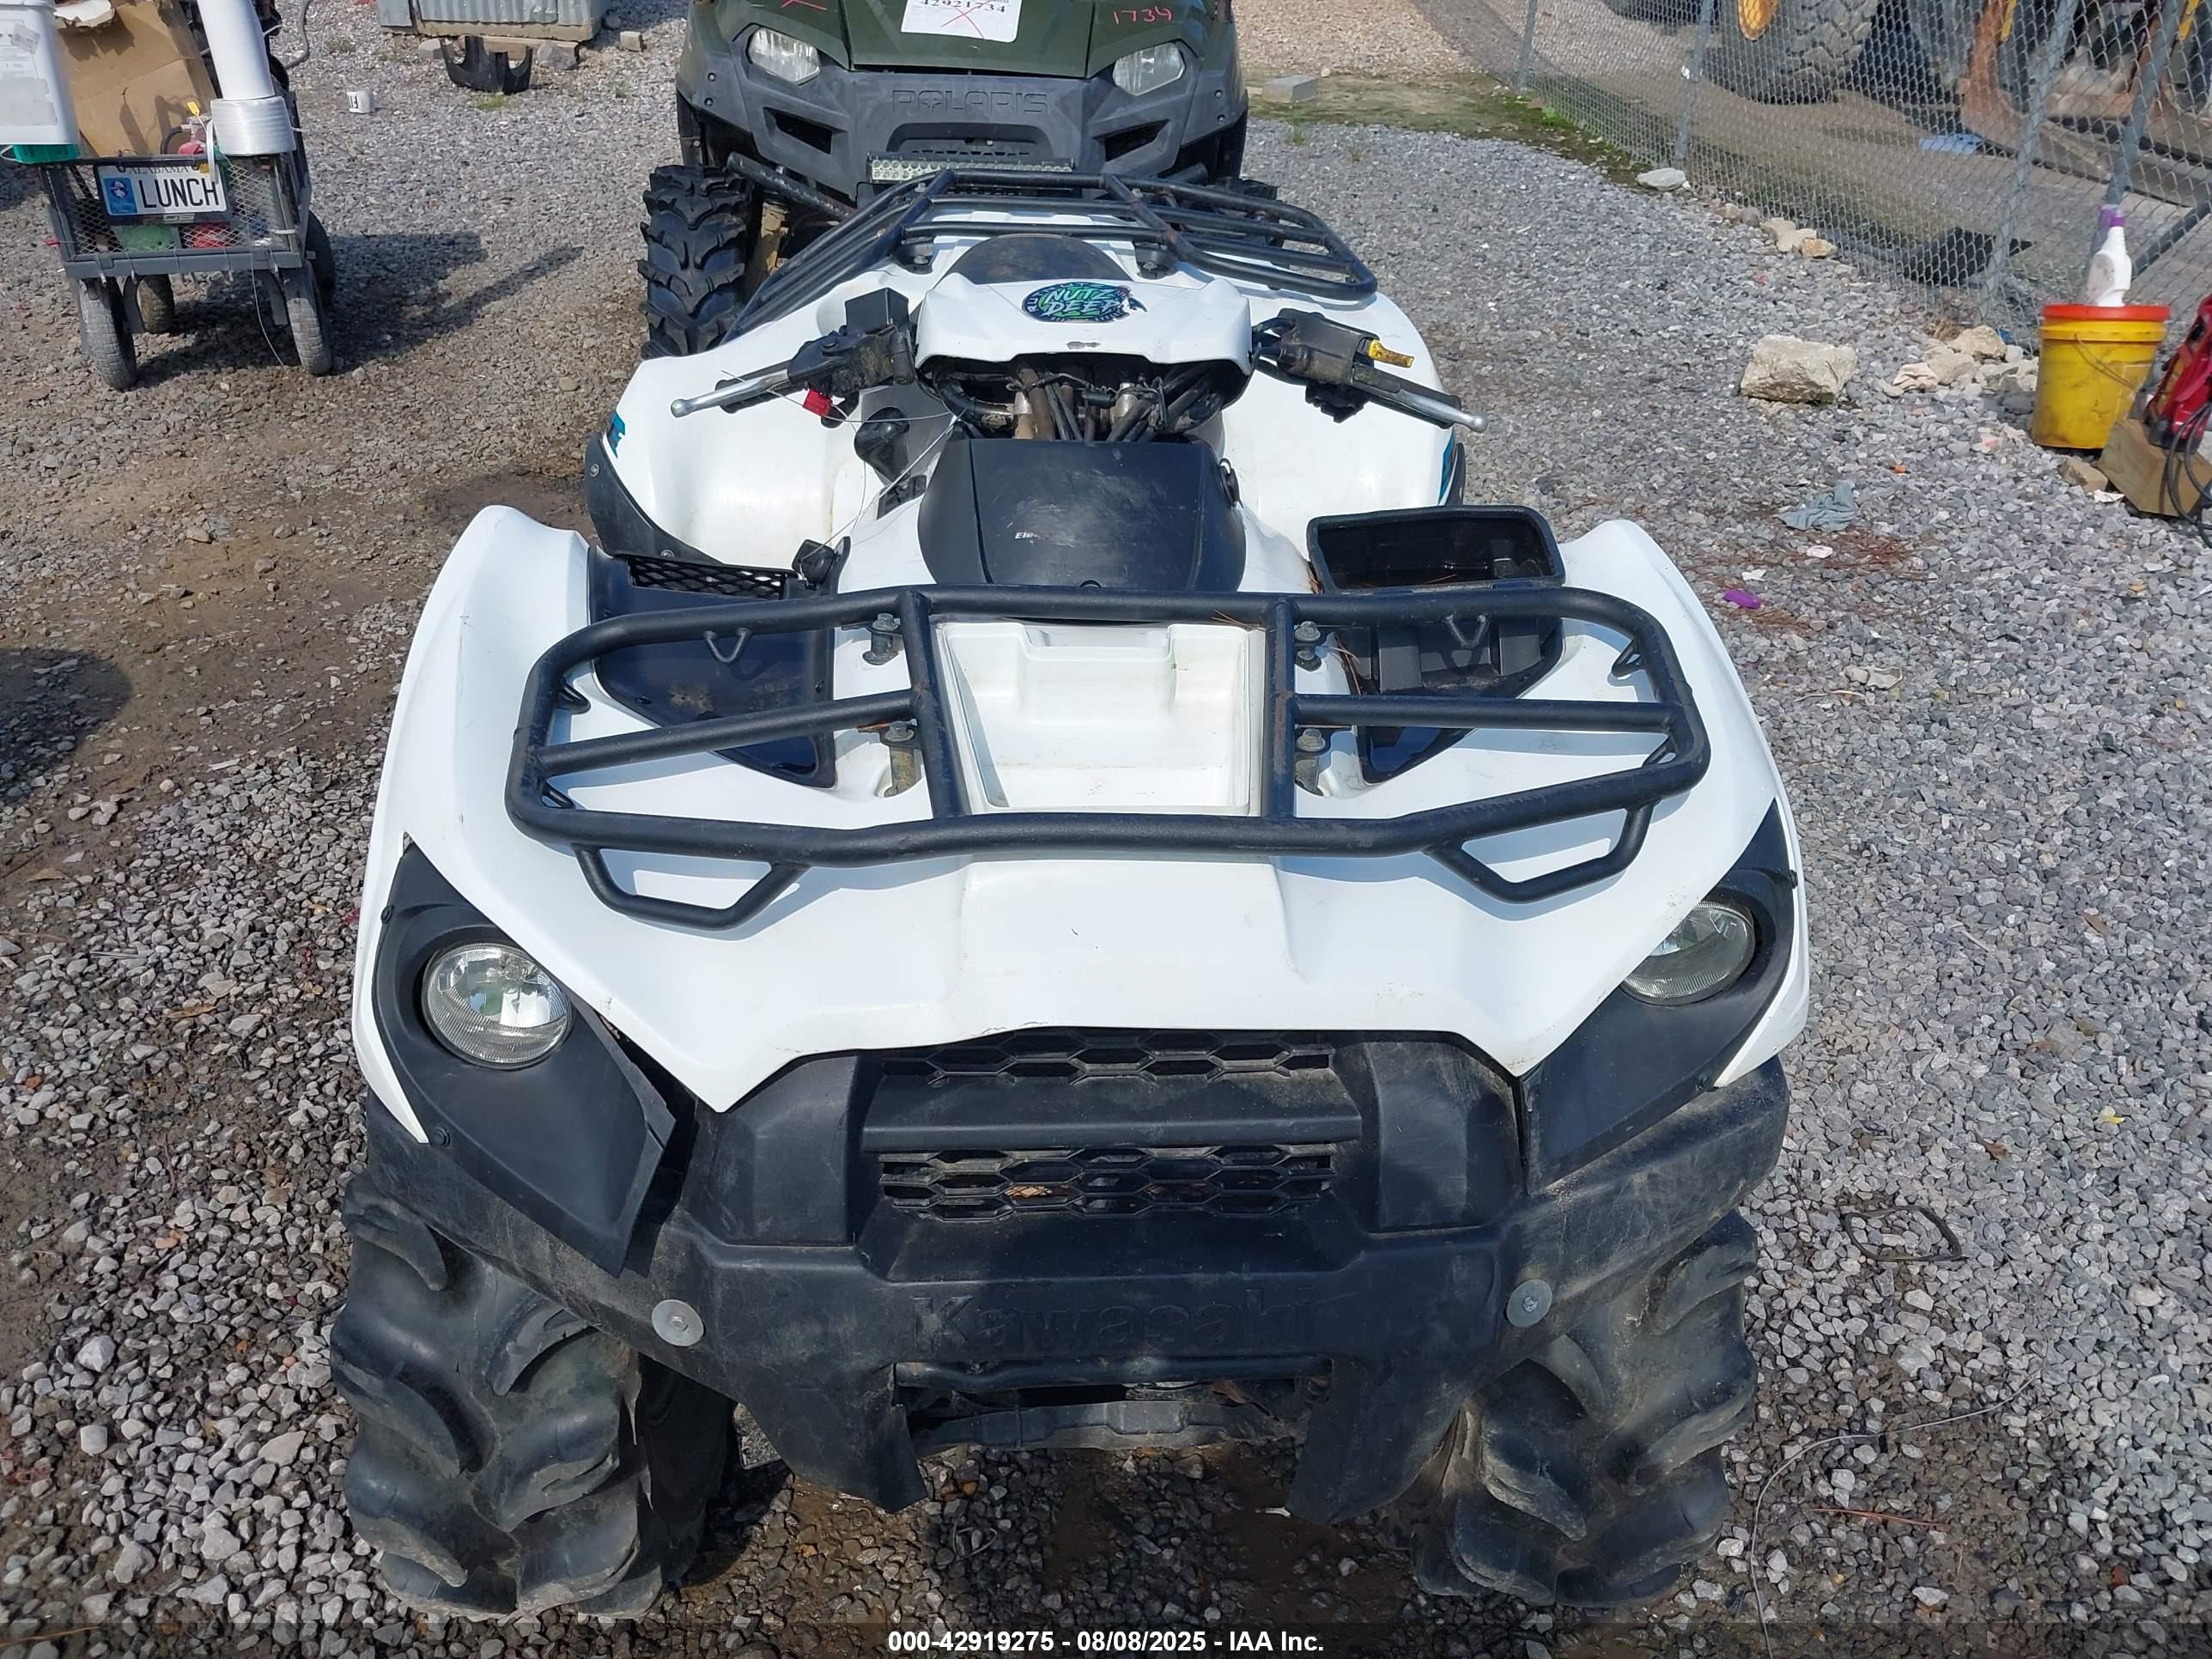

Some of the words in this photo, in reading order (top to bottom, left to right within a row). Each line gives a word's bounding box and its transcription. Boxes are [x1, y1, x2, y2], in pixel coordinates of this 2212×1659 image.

[921, 0, 1006, 13] 42921734
[1113, 5, 1172, 24] 1734
[892, 89, 1048, 116] POLARIS
[138, 177, 220, 209] LUNCH
[1044, 289, 1115, 303] NUTZ
[1041, 300, 1121, 316] DEEP
[910, 1286, 1317, 1353] Kawasaki
